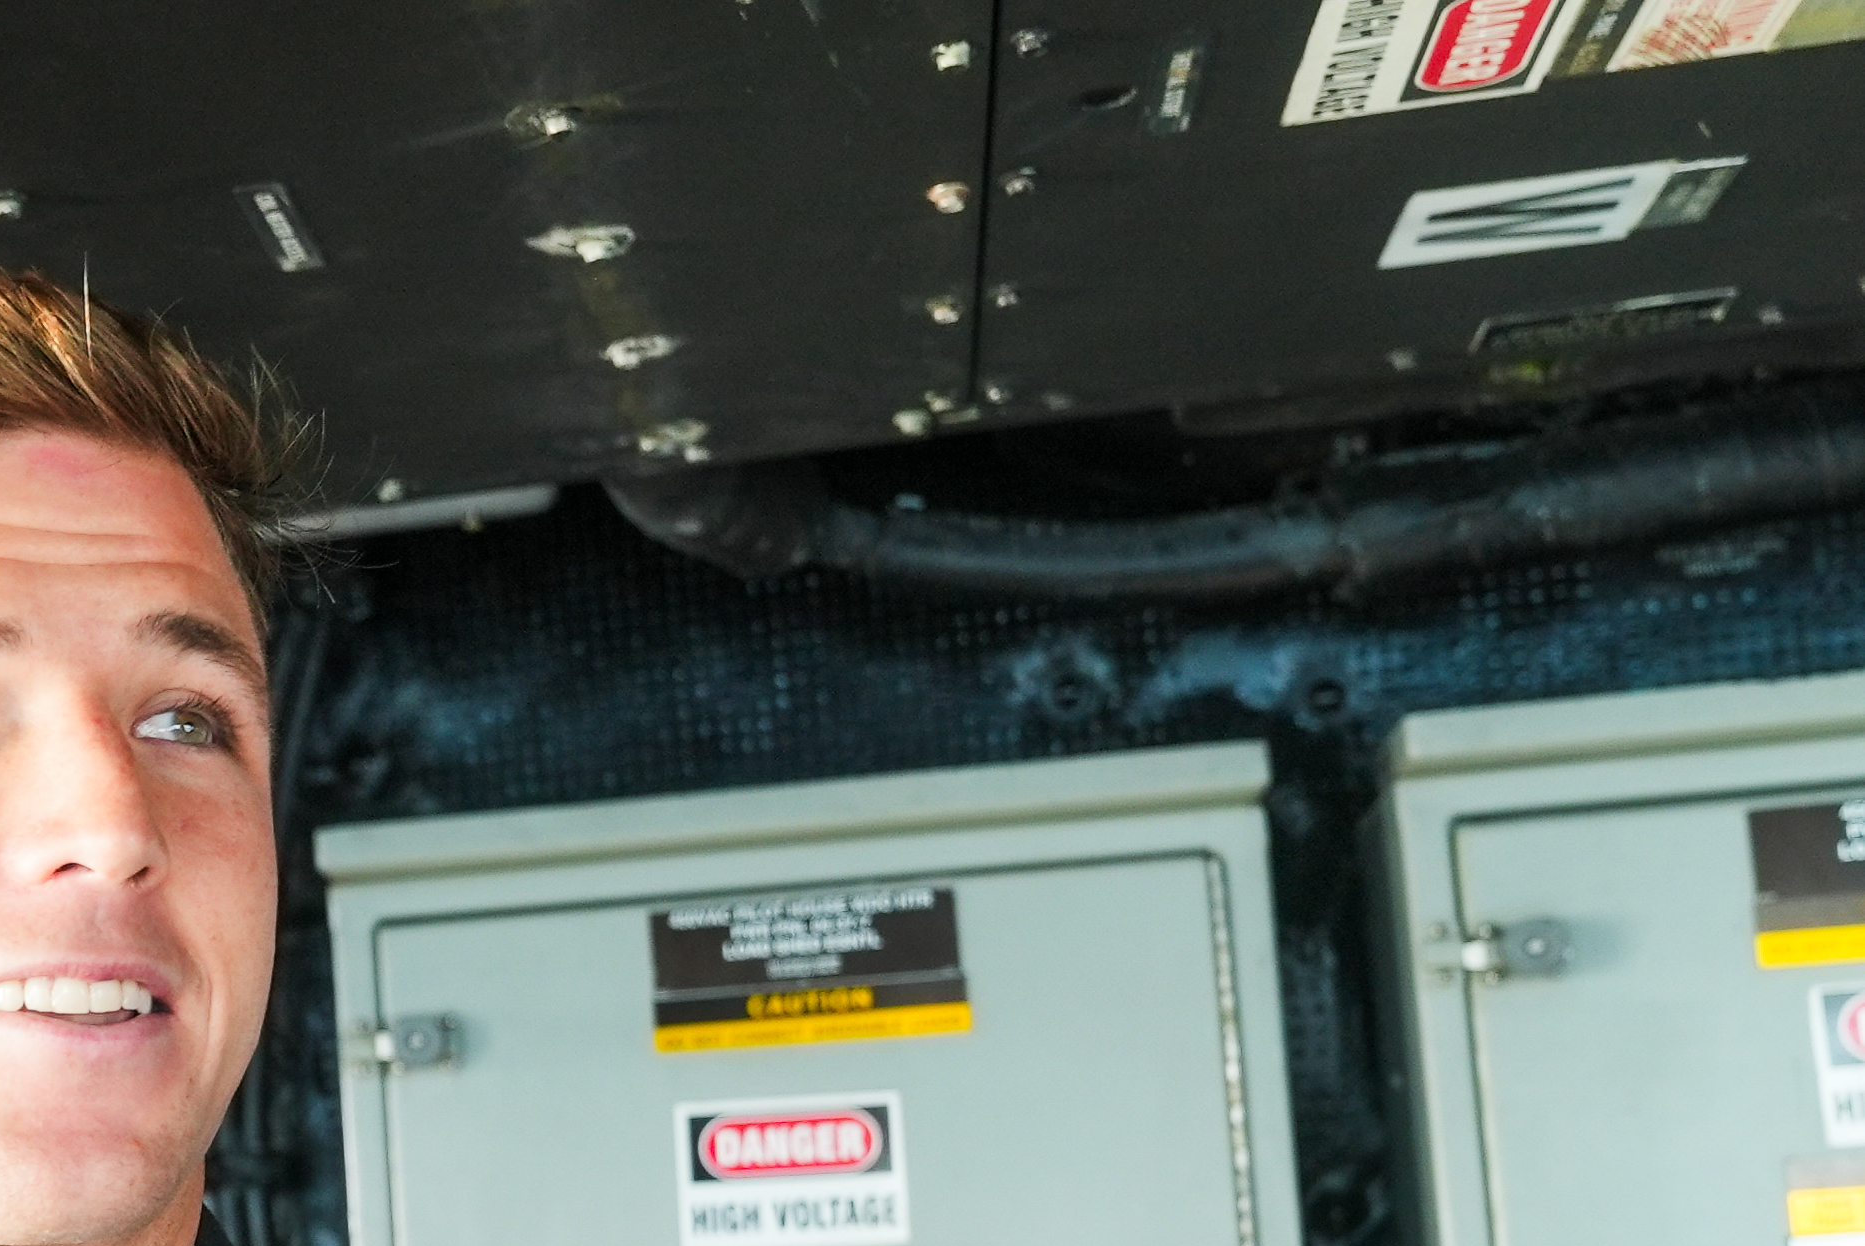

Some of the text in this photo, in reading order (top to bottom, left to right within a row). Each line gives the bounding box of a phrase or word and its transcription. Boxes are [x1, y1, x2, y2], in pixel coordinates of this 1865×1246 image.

[1313, 40, 1388, 118] VOLTAGE
[746, 985, 875, 1020] CAUTION
[713, 1119, 868, 1170] DANGER
[692, 1191, 897, 1236] HIGH VOLTAGE
